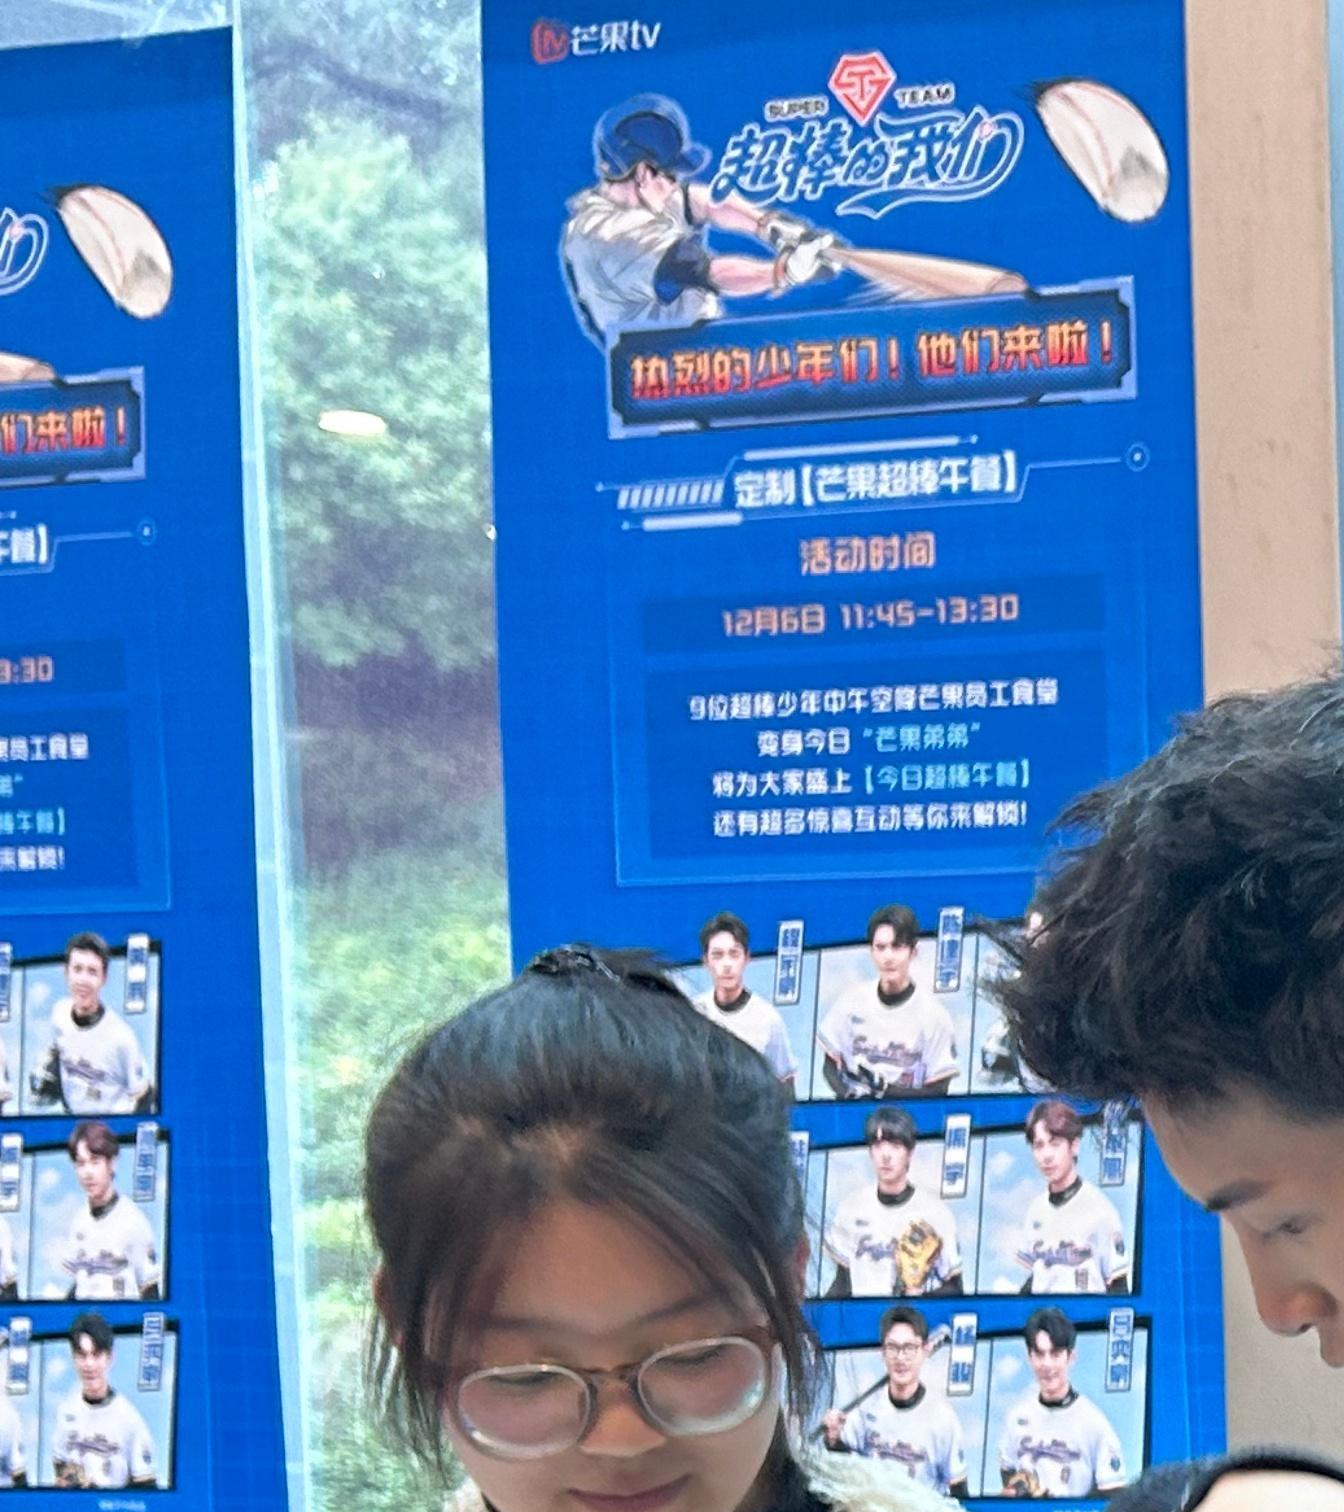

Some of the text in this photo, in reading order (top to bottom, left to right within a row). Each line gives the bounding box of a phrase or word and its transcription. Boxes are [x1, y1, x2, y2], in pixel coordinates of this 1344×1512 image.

[898, 85, 953, 105] TEAM
[800, 531, 935, 576] 活动时间
[722, 593, 1018, 637] 12月6日 11:45-13:30
